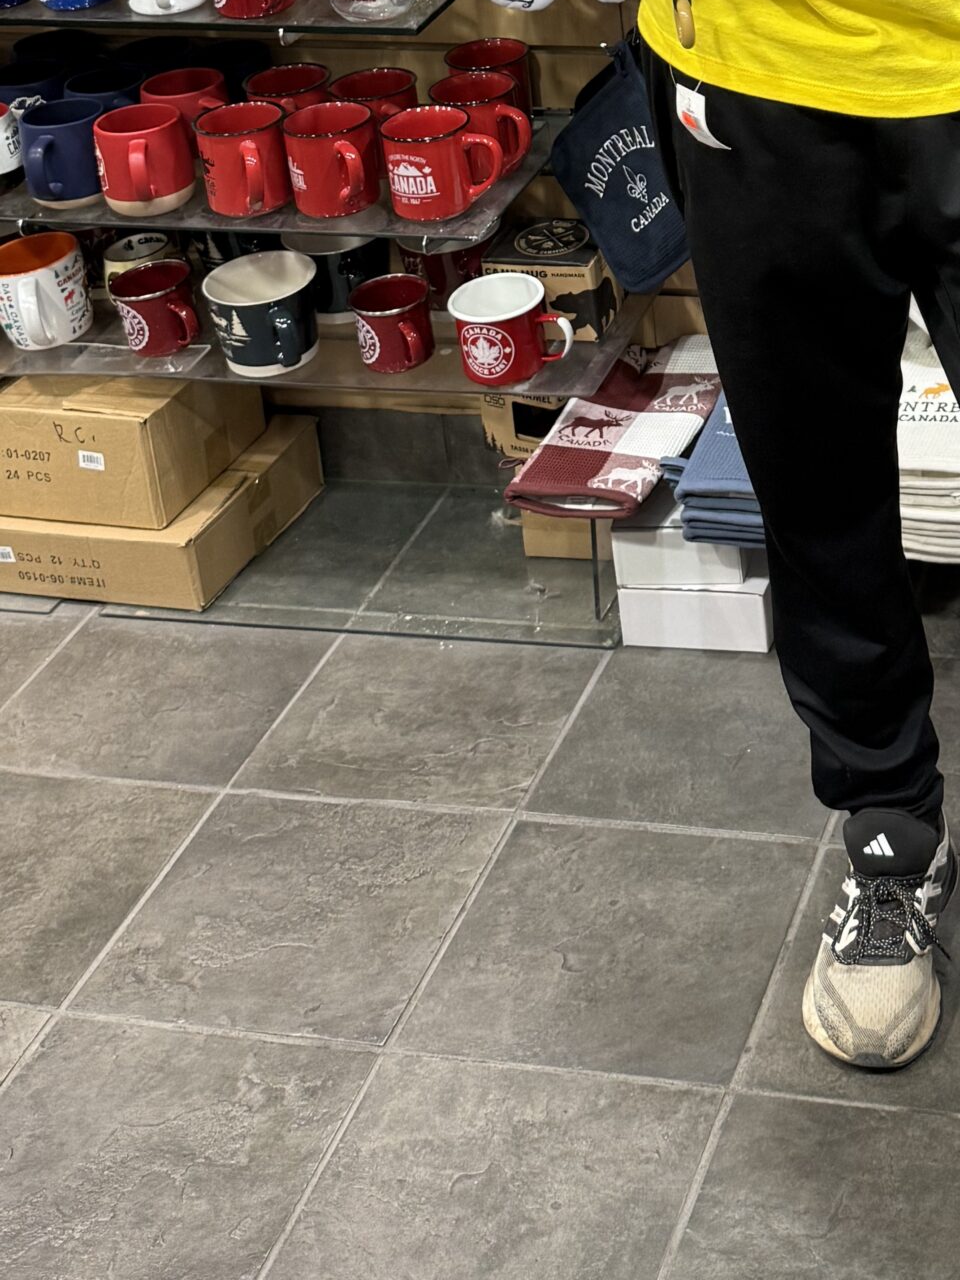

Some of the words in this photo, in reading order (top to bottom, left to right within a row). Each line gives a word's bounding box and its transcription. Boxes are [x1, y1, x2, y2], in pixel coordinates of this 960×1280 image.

[585, 124, 655, 199] MONTREAL
[389, 172, 438, 195] CANADA
[631, 191, 670, 233] CANADA
[463, 326, 502, 340] CANADA
[654, 403, 708, 413] CANADA
[899, 401, 960, 413] NTRE
[898, 414, 960, 423] CANADA
[559, 433, 613, 447] CANADA
[5, 470, 22, 482] 24
[26, 471, 52, 483] PCS
[17, 553, 42, 564] PCS
[50, 555, 63, 566] 12
